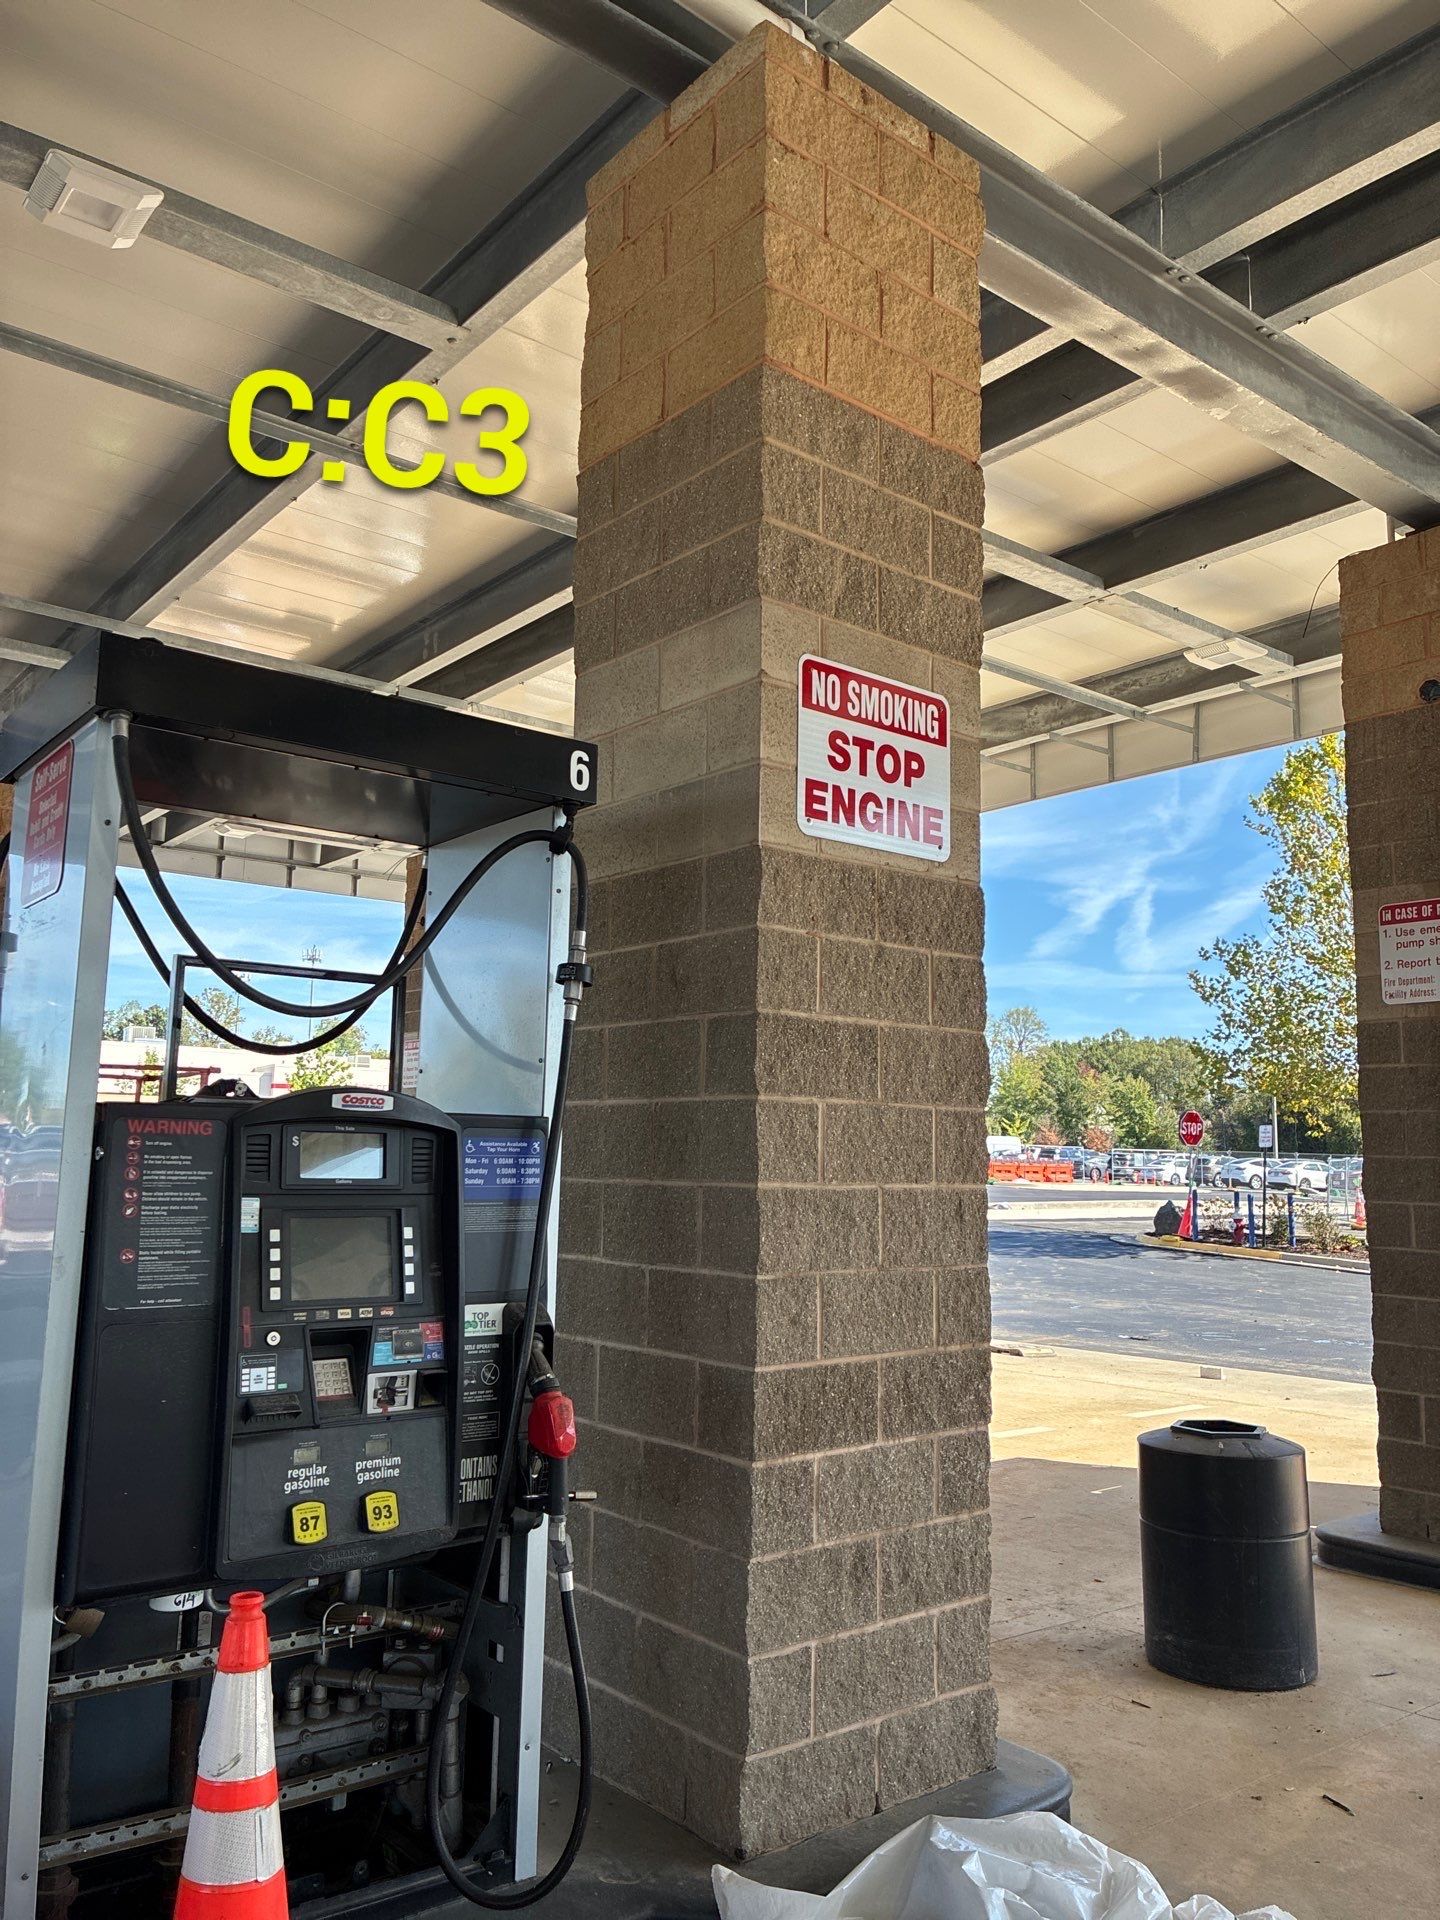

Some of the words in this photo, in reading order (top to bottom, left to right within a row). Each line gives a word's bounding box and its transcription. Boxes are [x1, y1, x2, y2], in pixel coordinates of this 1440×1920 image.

[811, 669, 841, 711] NO
[847, 680, 940, 740] SMOKING
[827, 729, 926, 788] STOP
[35, 756, 68, 793] Self-Serve
[569, 750, 590, 791] 6
[804, 778, 944, 846] ENGINE
[1382, 909, 1391, 921] IN
[1395, 906, 1418, 921] CASE
[1422, 904, 1433, 917] OF
[1383, 929, 1391, 939] 1.
[1395, 927, 1415, 938] Use
[1396, 939, 1425, 951] pump
[1384, 960, 1393, 970] 2.
[1397, 957, 1431, 970] Report
[1384, 978, 1396, 988] Fire
[1398, 975, 1436, 987] Department:
[1385, 990, 1407, 1000] Facility
[1409, 988, 1437, 998] Address:
[127, 1119, 213, 1136] WARNING
[1181, 1122, 1203, 1135] STOP
[292, 1136, 299, 1147] $
[472, 1311, 489, 1320] TOP
[478, 1320, 497, 1329] TIER
[287, 1464, 327, 1480] regular
[355, 1456, 402, 1473] premium
[460, 1454, 498, 1480] ONTAINS
[357, 1467, 400, 1485] gasoline
[284, 1476, 330, 1494] gasoline
[459, 1478, 495, 1503] THANOL
[372, 1504, 393, 1521] 93
[299, 1515, 320, 1533] 87
